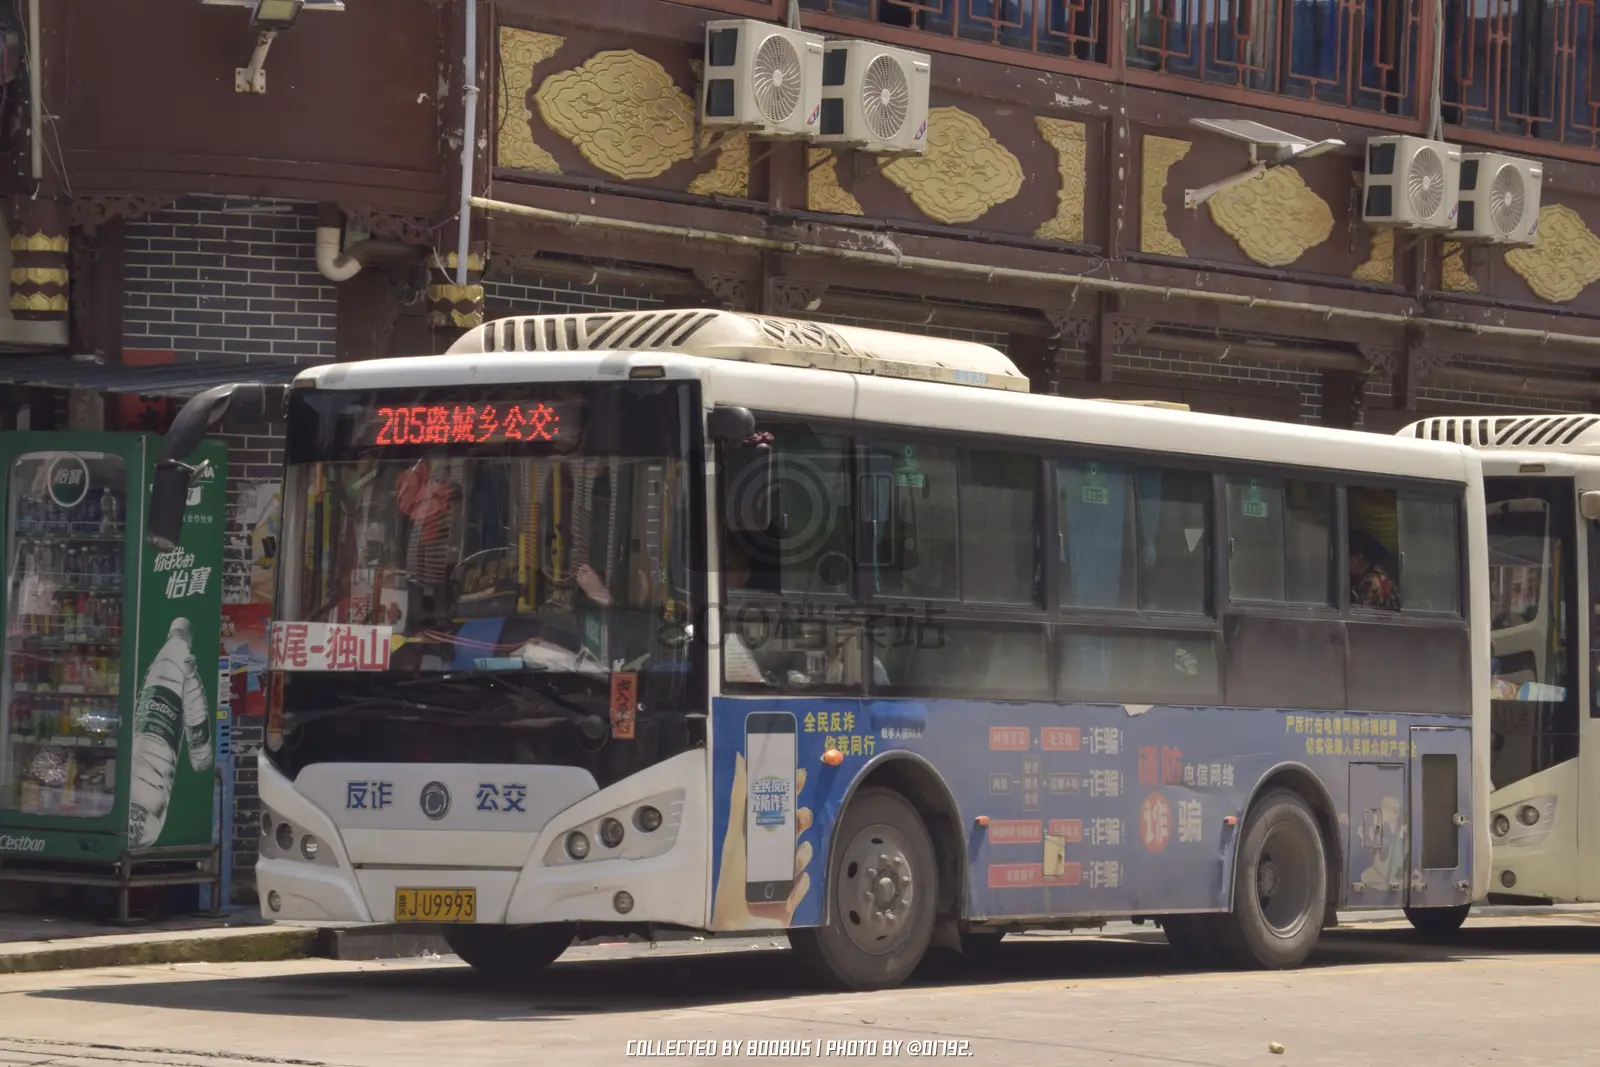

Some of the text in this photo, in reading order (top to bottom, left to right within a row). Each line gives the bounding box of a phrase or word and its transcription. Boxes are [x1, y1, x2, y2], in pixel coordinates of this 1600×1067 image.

[165, 566, 211, 599] 怡寶
[804, 711, 855, 733] 全民反诈
[824, 735, 875, 756] 你我同行
[346, 781, 527, 813] 反诈 公交
